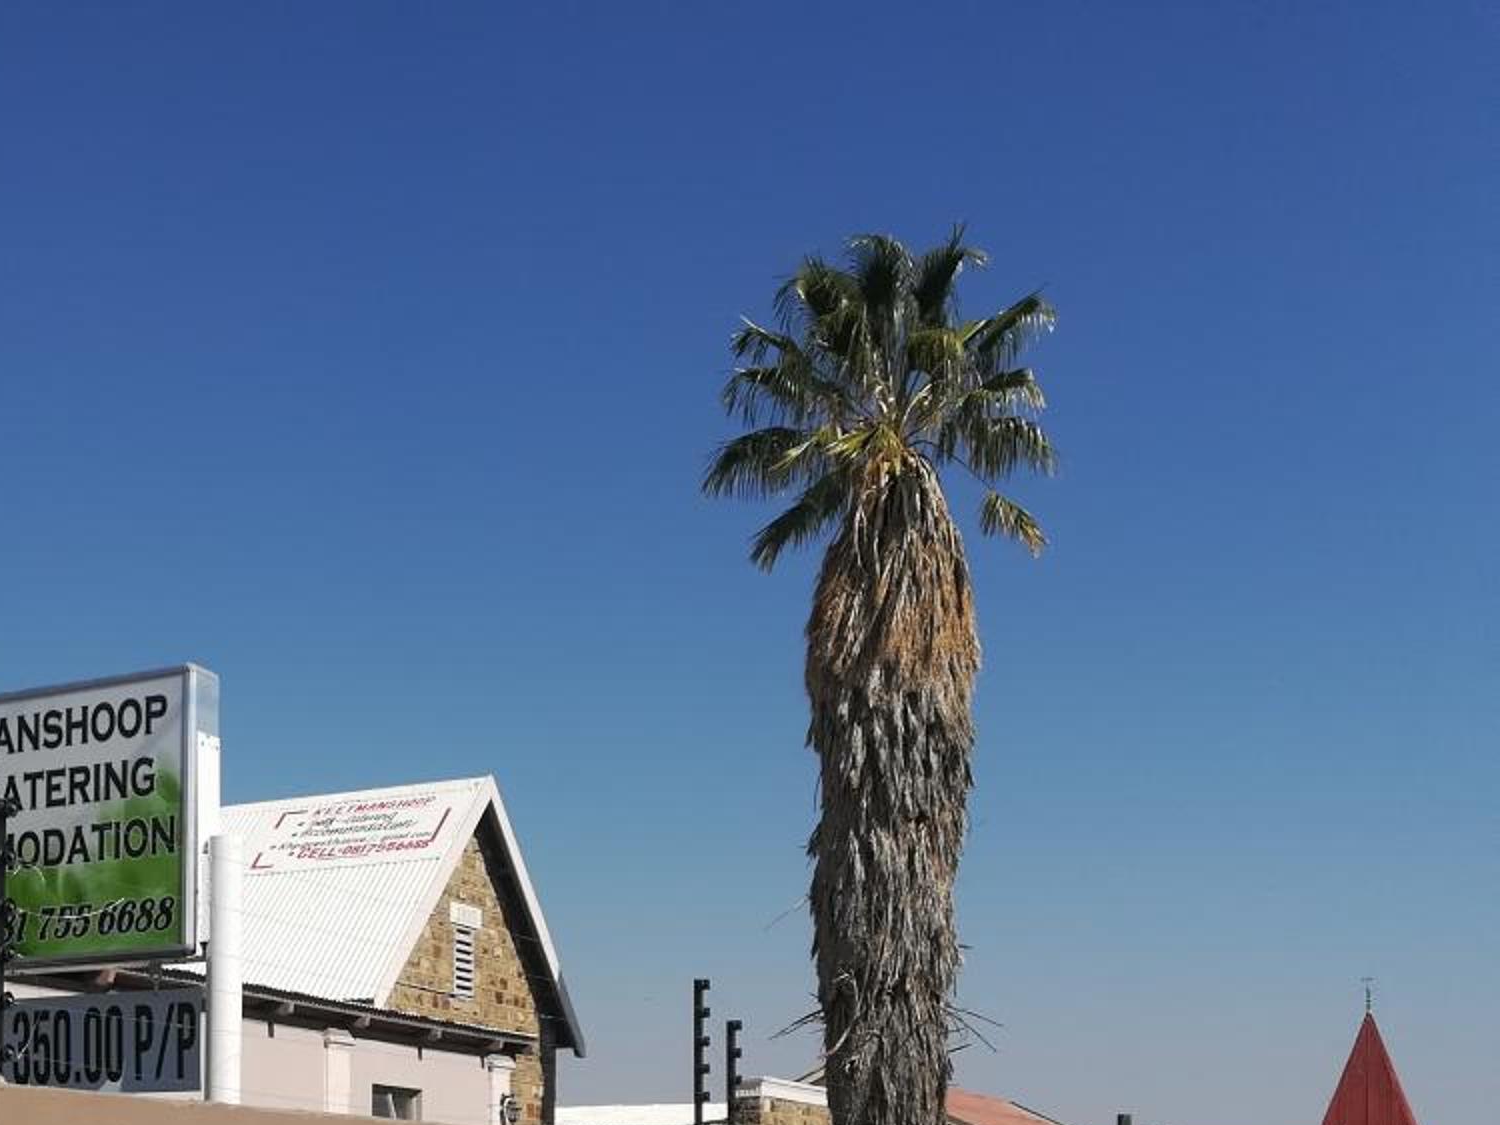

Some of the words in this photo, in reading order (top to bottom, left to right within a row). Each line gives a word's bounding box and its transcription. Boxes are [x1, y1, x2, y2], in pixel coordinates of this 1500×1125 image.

[39, 906, 91, 940] 755
[99, 897, 175, 933] 6688
[133, 1001, 197, 1082] P/P
